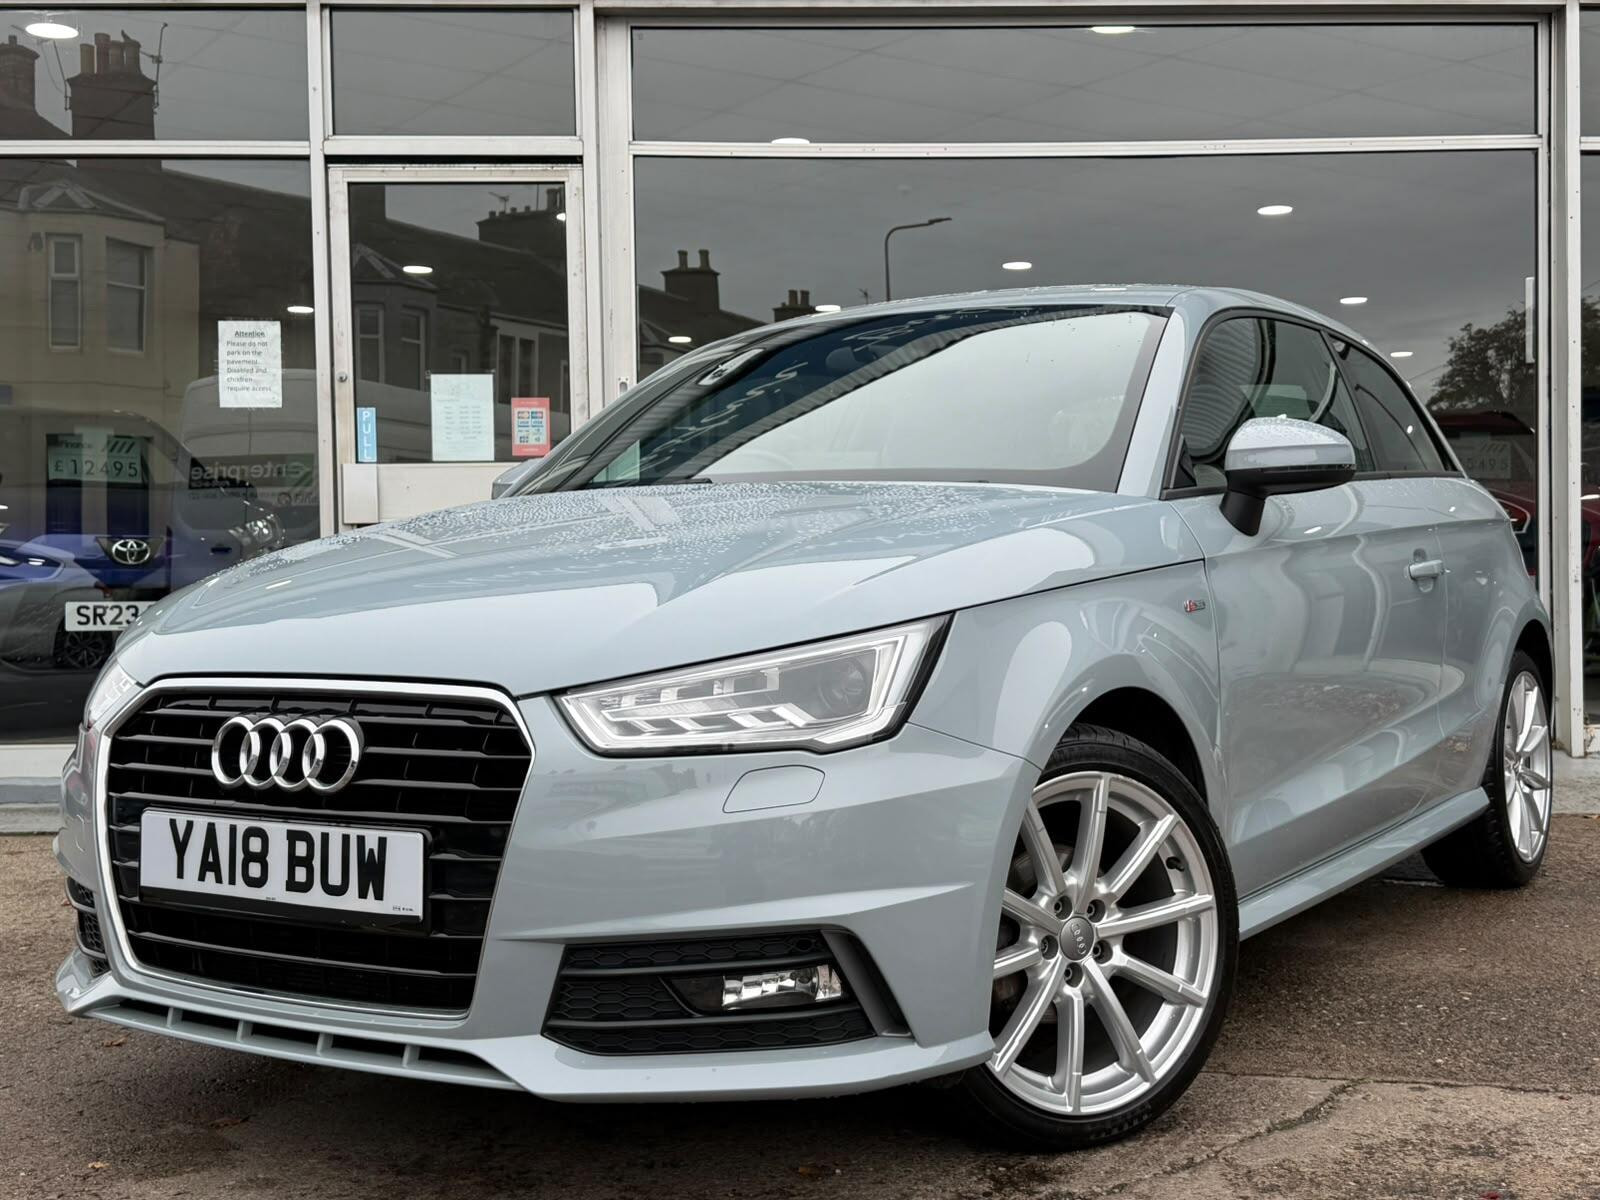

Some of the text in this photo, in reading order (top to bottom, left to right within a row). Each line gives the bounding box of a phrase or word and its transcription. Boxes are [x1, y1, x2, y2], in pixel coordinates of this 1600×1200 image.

[227, 349, 241, 357] park
[362, 410, 373, 459] PULL
[76, 605, 139, 625] SR23
[169, 818, 388, 901] YA18 BUW
